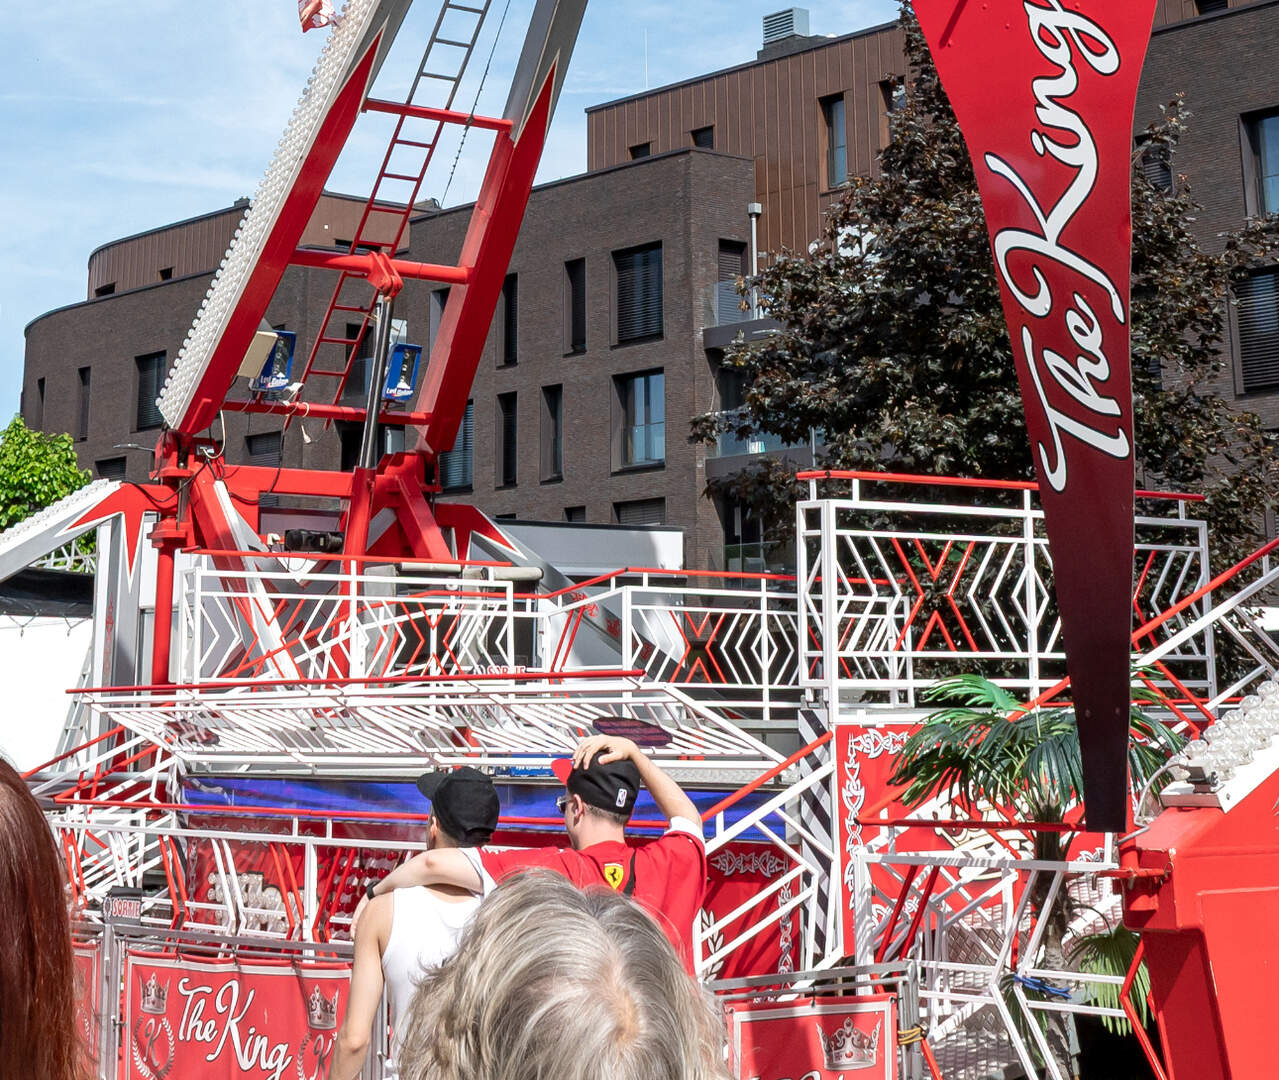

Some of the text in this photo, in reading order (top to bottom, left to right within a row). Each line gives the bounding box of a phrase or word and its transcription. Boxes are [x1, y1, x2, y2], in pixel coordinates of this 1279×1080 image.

[1019, 291, 1130, 493] The
[177, 977, 293, 1080] The King
